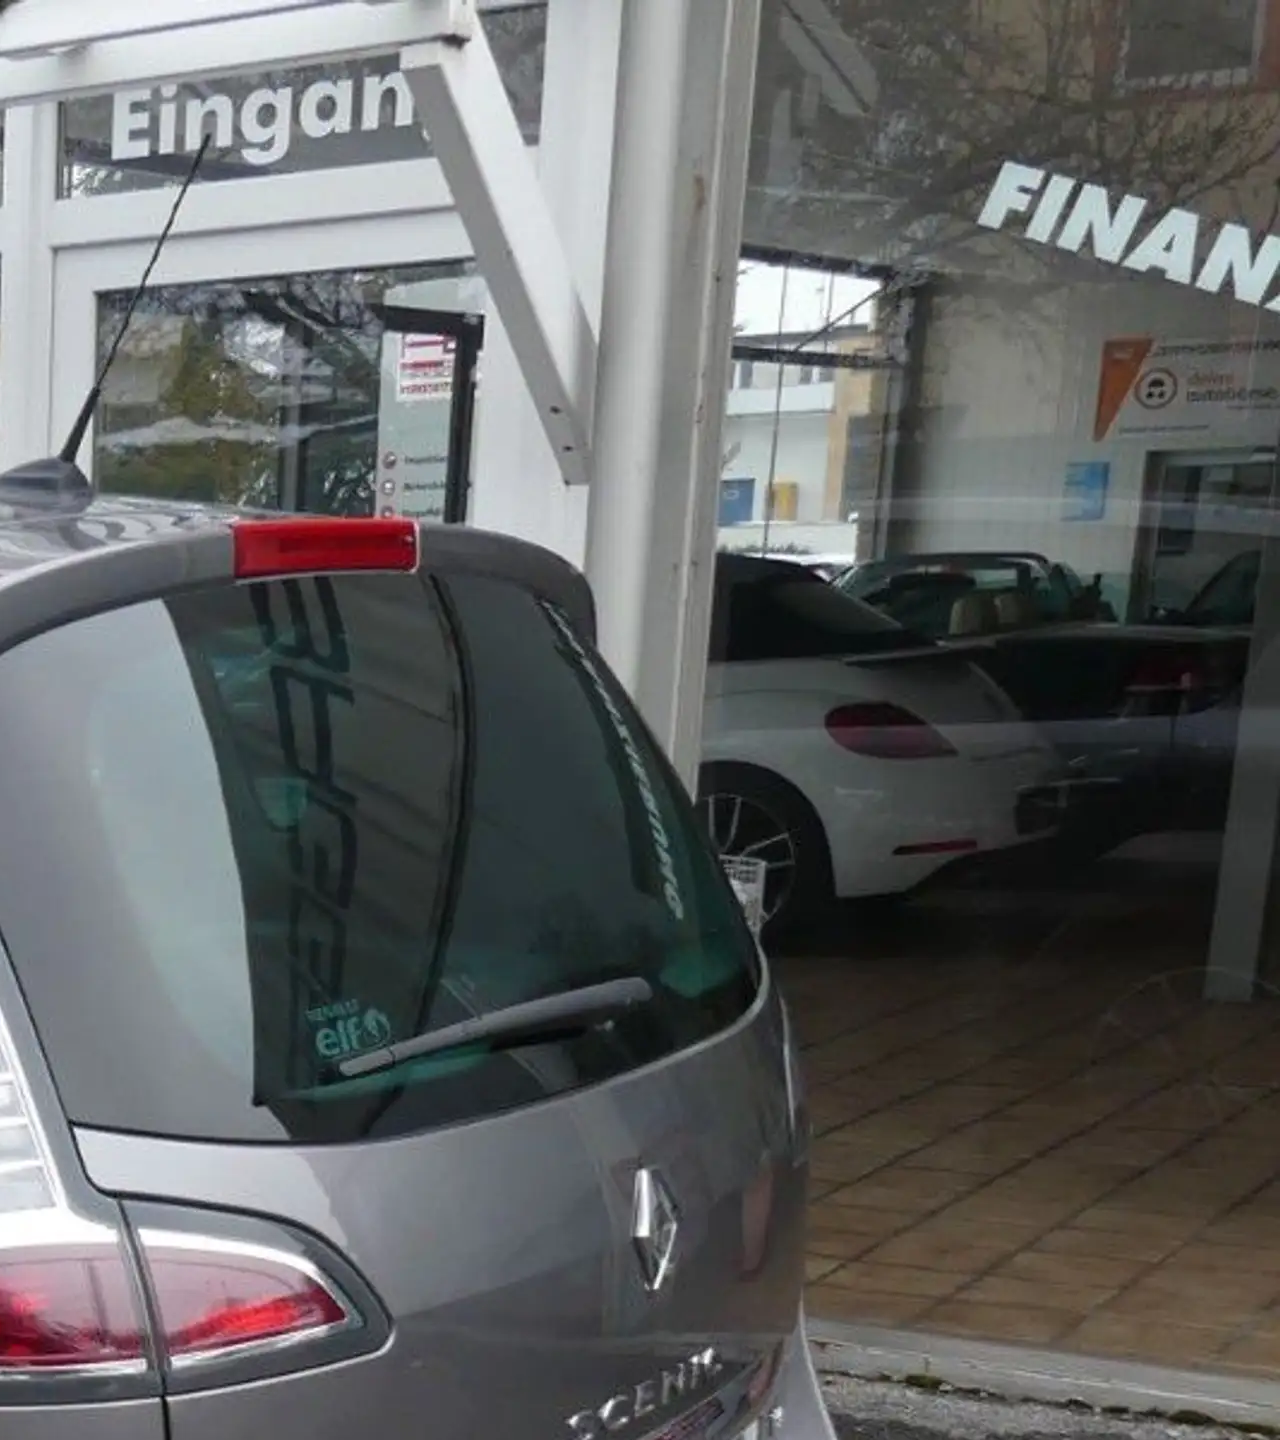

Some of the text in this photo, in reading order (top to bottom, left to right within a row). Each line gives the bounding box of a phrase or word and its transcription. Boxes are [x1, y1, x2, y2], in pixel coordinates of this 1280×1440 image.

[111, 71, 431, 166] Eingan
[977, 161, 1280, 313] FINAN
[316, 1016, 362, 1056] elf
